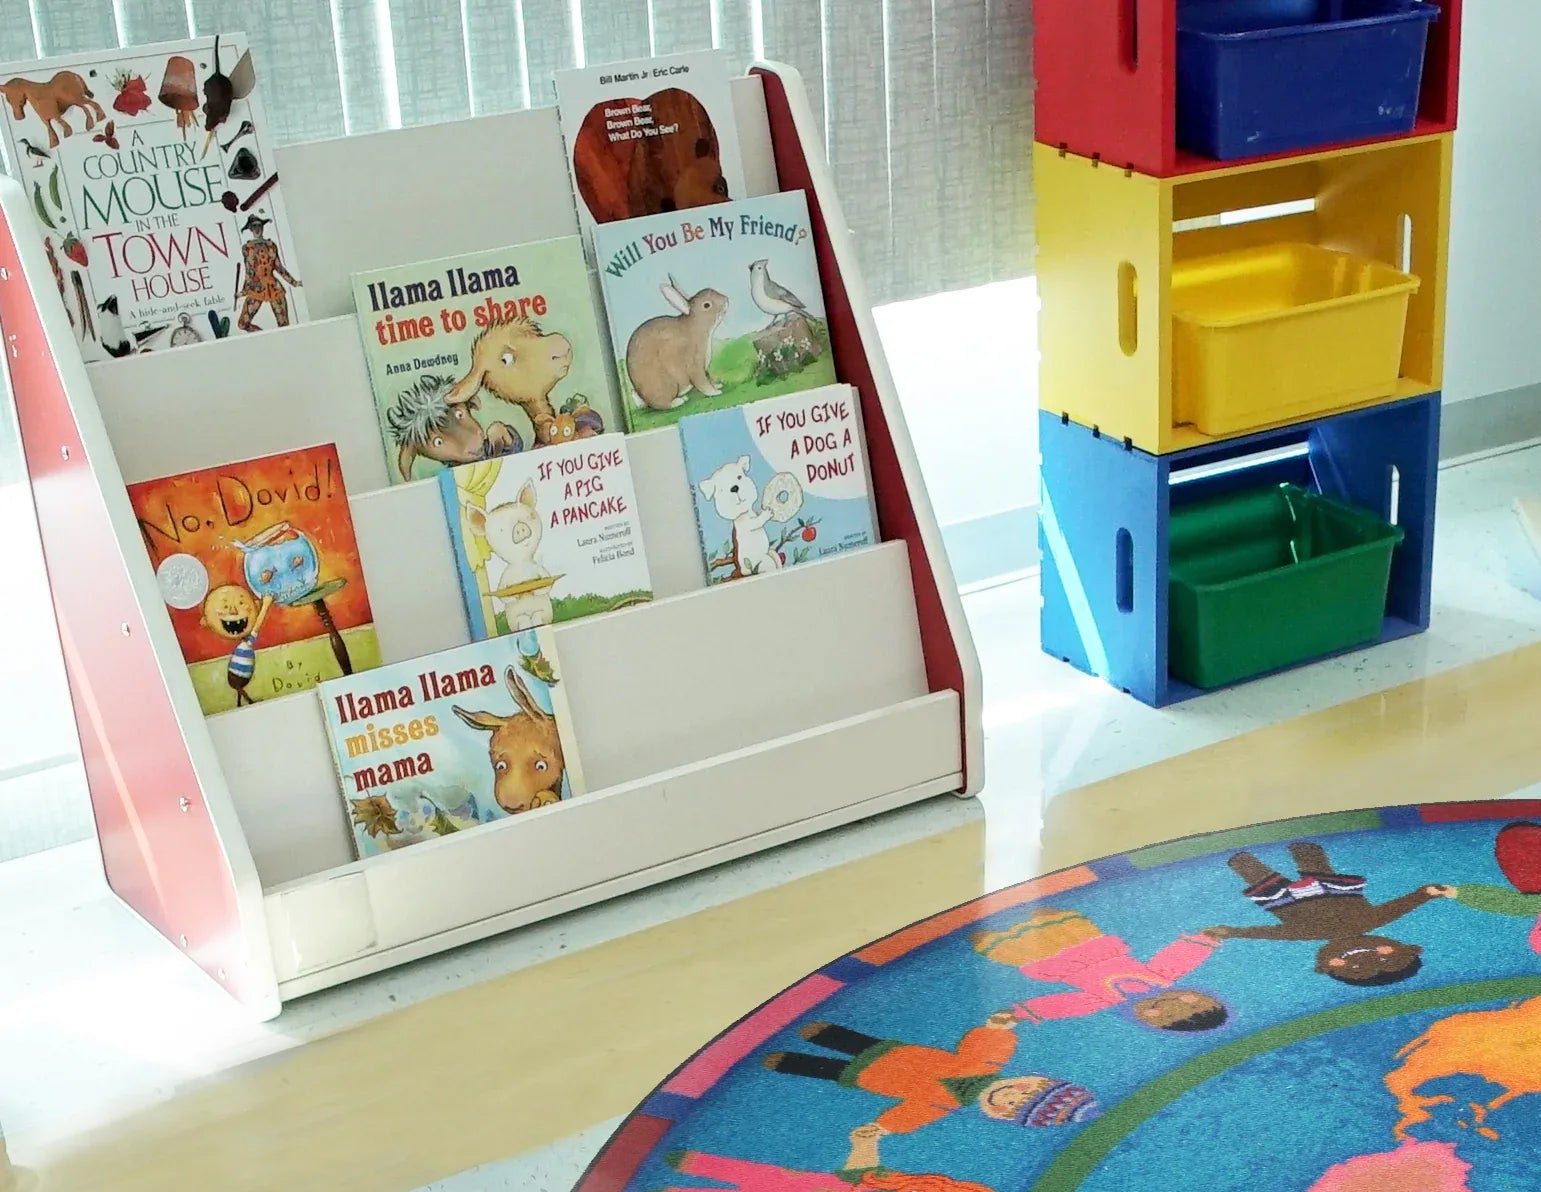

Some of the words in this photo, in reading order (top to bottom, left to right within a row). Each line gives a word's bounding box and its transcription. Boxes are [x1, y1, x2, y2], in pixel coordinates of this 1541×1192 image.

[600, 75, 612, 85] Bill
[614, 71, 639, 82] Martin
[653, 68, 668, 78] Eric
[604, 106, 631, 118] Brown
[606, 119, 633, 130] Brown
[131, 129, 144, 147] A
[608, 131, 630, 142] What
[631, 129, 642, 139] Do
[642, 127, 658, 137] You
[659, 123, 679, 134] See?
[83, 141, 198, 182] COUNTRY
[82, 164, 225, 230] MOUSE
[135, 218, 152, 232] IN
[154, 213, 179, 230] THE
[92, 222, 230, 278] TOWN
[605, 241, 643, 279] Will
[642, 233, 678, 255] You
[680, 222, 704, 244] Be
[708, 215, 734, 241] My
[739, 214, 808, 246] Friend?
[131, 266, 213, 302] HOUSE
[367, 277, 443, 312] llama
[446, 265, 521, 298] llama
[375, 313, 435, 346] time
[440, 308, 467, 333] to
[474, 294, 547, 328] share
[386, 363, 411, 376] Anna
[756, 414, 772, 437] IF
[776, 409, 806, 431] YOU
[811, 401, 850, 423] GIVE
[791, 439, 800, 460] A
[803, 432, 837, 455] DOG
[843, 428, 852, 448] A
[537, 461, 553, 481] IF
[556, 454, 583, 476] YOU
[587, 448, 623, 472] GIVE
[806, 452, 855, 484] DONUT
[564, 482, 573, 501] A
[575, 475, 604, 497] PIG
[550, 510, 559, 529] A
[562, 496, 627, 525] PANCAKE
[334, 685, 415, 724] llama
[418, 664, 497, 702] llama
[345, 715, 440, 759] misses
[353, 752, 434, 792] mama
